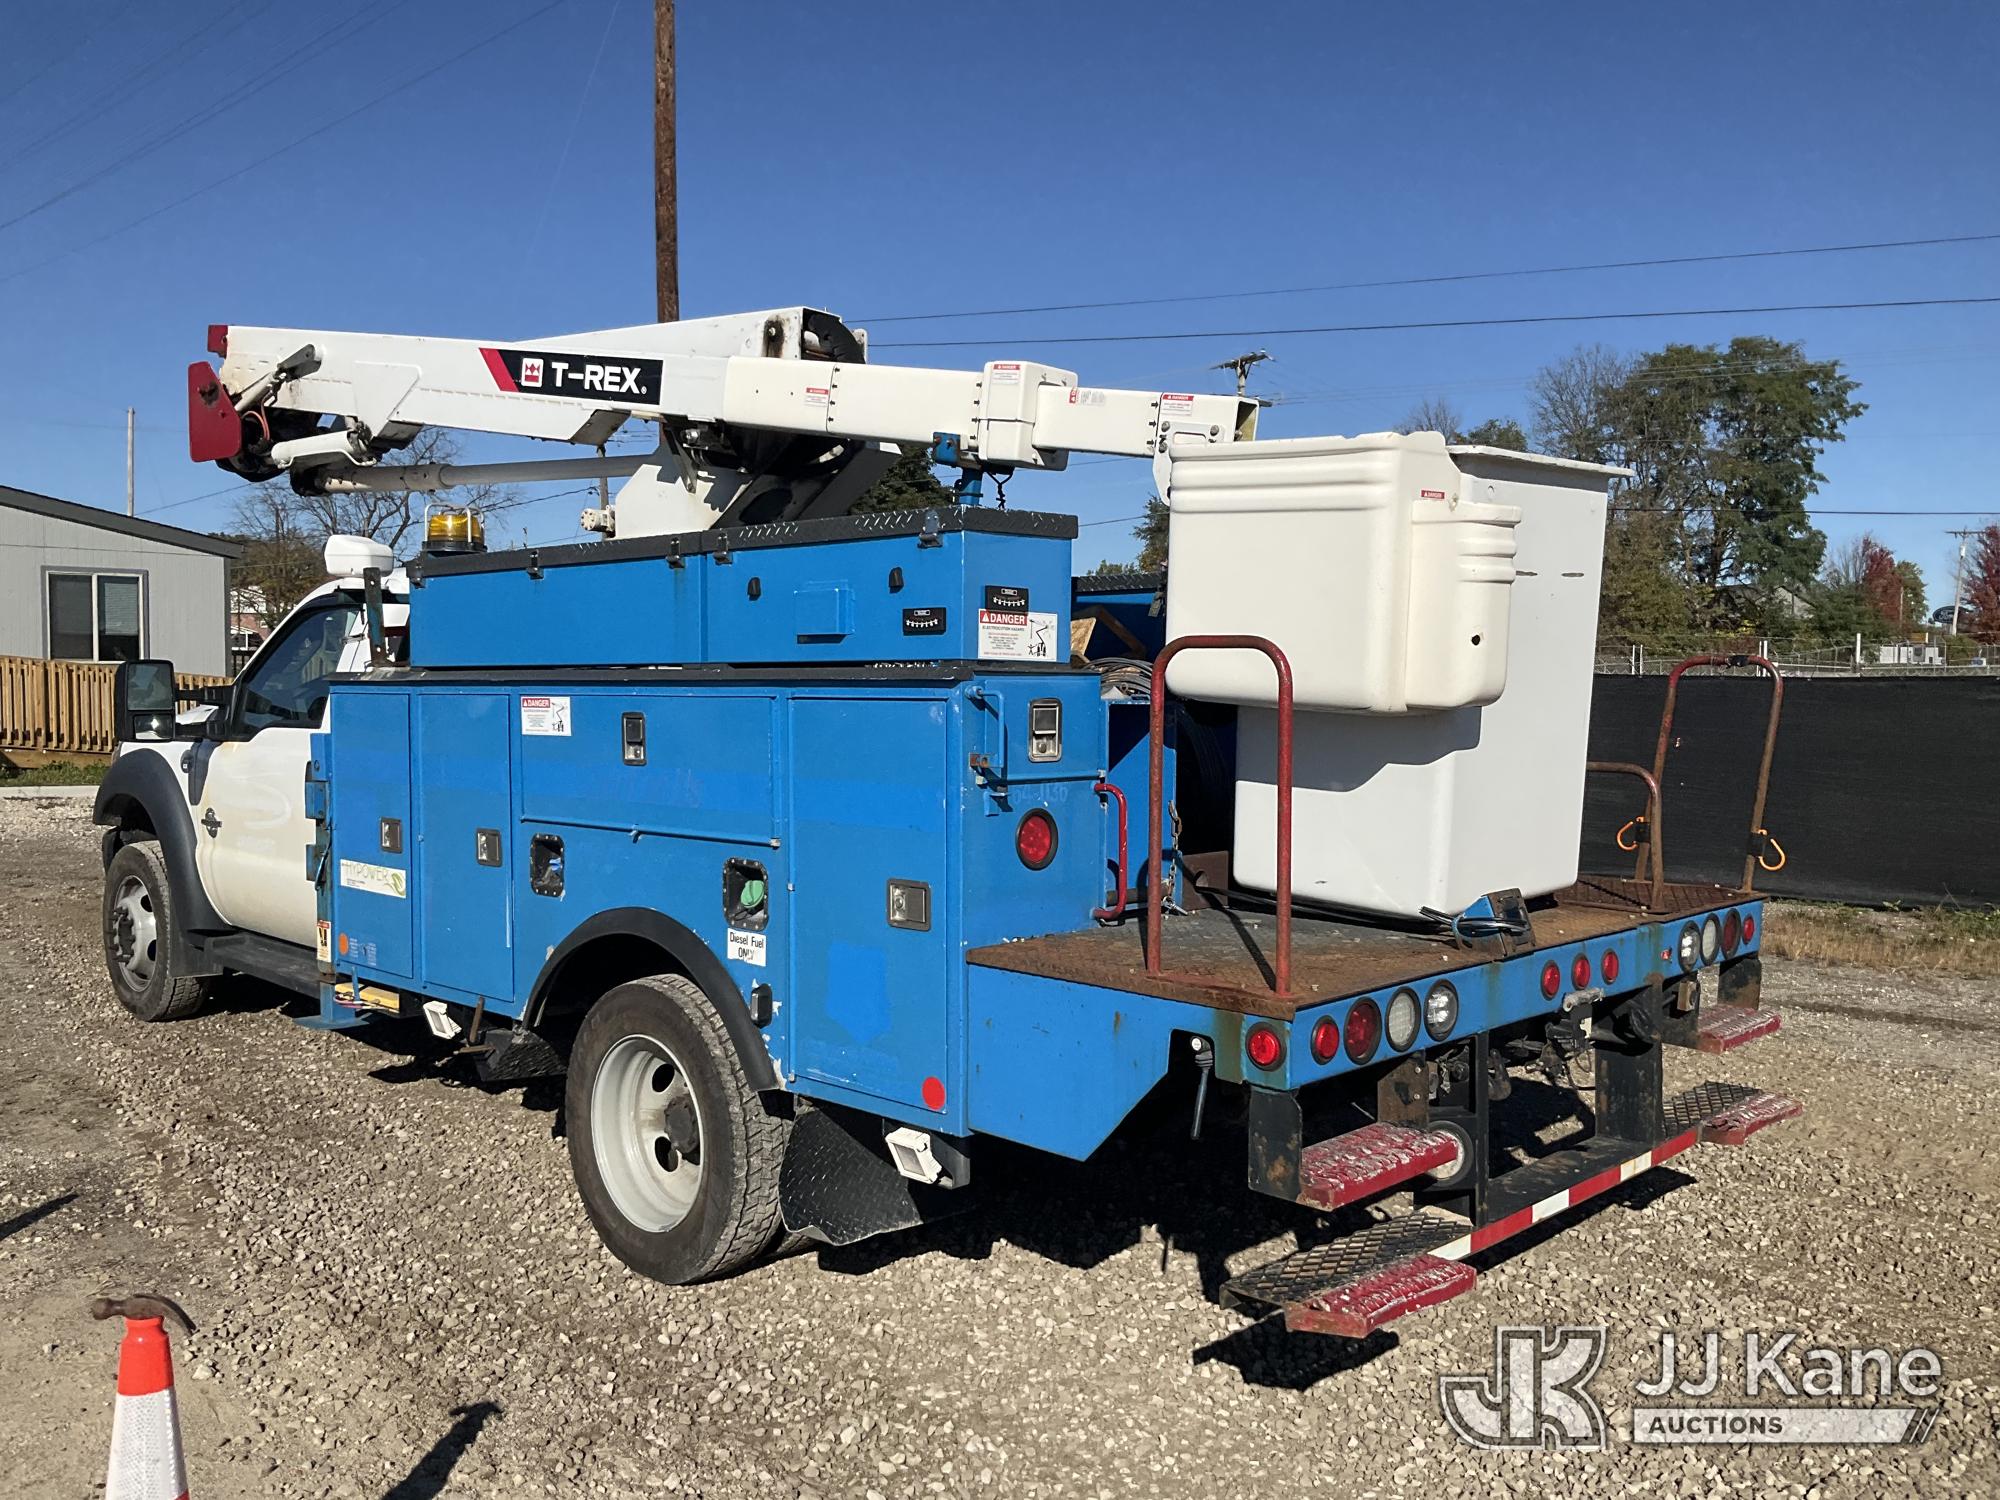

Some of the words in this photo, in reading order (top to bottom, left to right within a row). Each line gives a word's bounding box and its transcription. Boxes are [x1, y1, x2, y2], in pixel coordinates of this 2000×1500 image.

[990, 613, 1025, 625] DANGER
[528, 699, 549, 707] DANGER
[729, 931, 749, 946] Diesel
[751, 936, 764, 949] Fuel
[738, 947, 755, 961] ONLY
